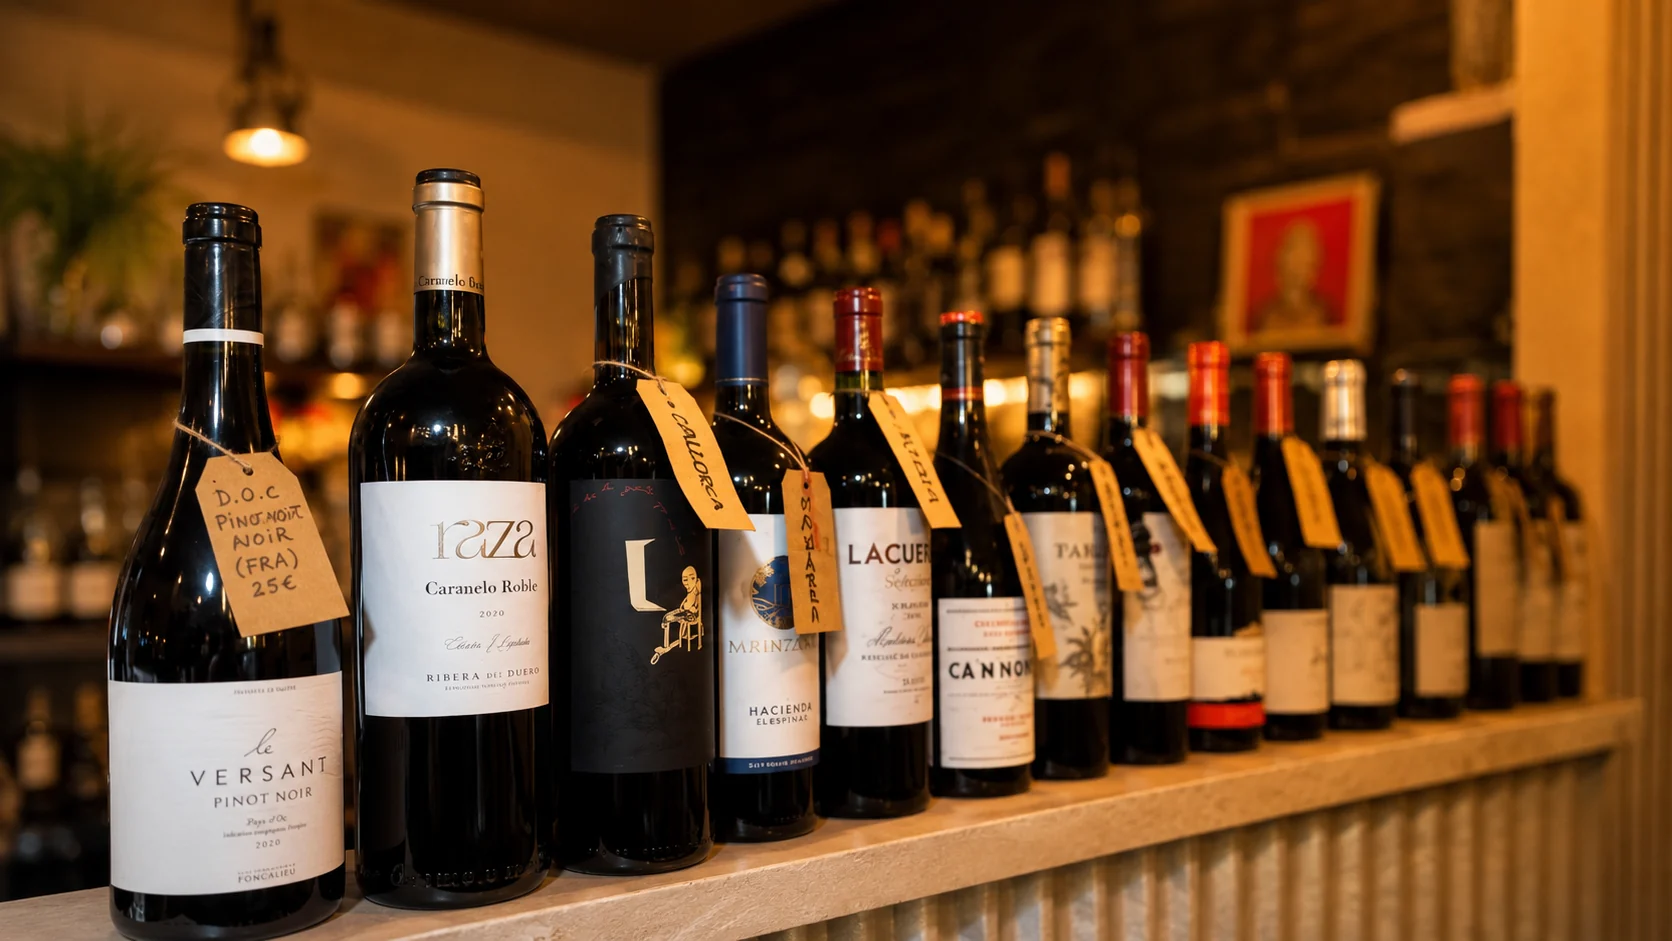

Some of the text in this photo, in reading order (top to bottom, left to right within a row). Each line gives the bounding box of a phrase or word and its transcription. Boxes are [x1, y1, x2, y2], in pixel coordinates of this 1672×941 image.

[215, 485, 280, 507] D.O.C
[430, 519, 537, 560] raza
[235, 548, 298, 578] (FRA)
[251, 575, 297, 598] 25€
[425, 578, 538, 596] Caranelo Roble
[479, 610, 505, 618] 2020
[426, 672, 480, 682] RIBERA
[507, 667, 540, 678] DUERO
[749, 702, 813, 717] HACIENDA
[243, 728, 277, 758] le
[190, 756, 327, 787] VERSANT
[214, 787, 313, 809] PINOT NOIR
[255, 839, 281, 850] 2020
[238, 867, 296, 884] FONCALIEU
